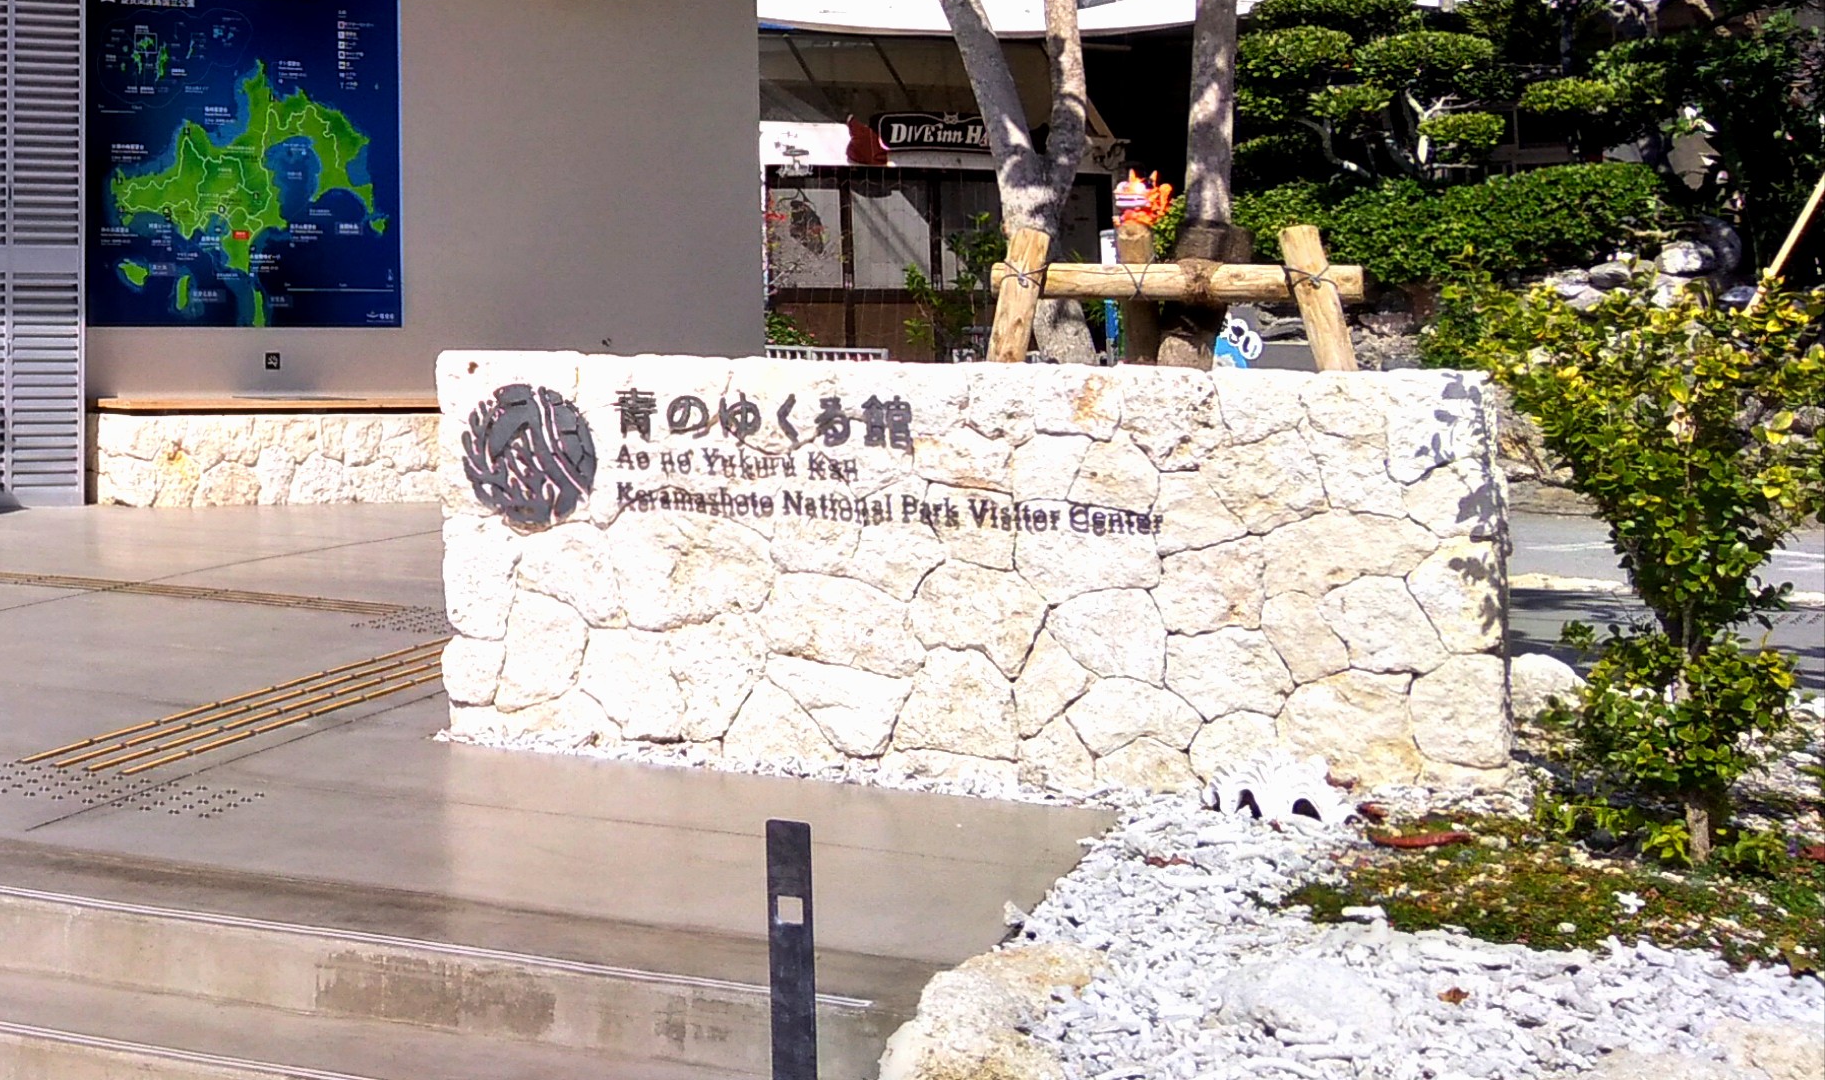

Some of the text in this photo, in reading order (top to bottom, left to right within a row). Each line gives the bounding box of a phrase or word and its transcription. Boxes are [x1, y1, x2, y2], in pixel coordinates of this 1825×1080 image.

[889, 123, 935, 143] DIVE
[964, 125, 990, 147] HA
[612, 387, 915, 450] 青のゆくる館
[615, 444, 860, 480] Ao no Yukuru Kan
[616, 481, 1165, 536] Keramashoto National Park Visitor Center
